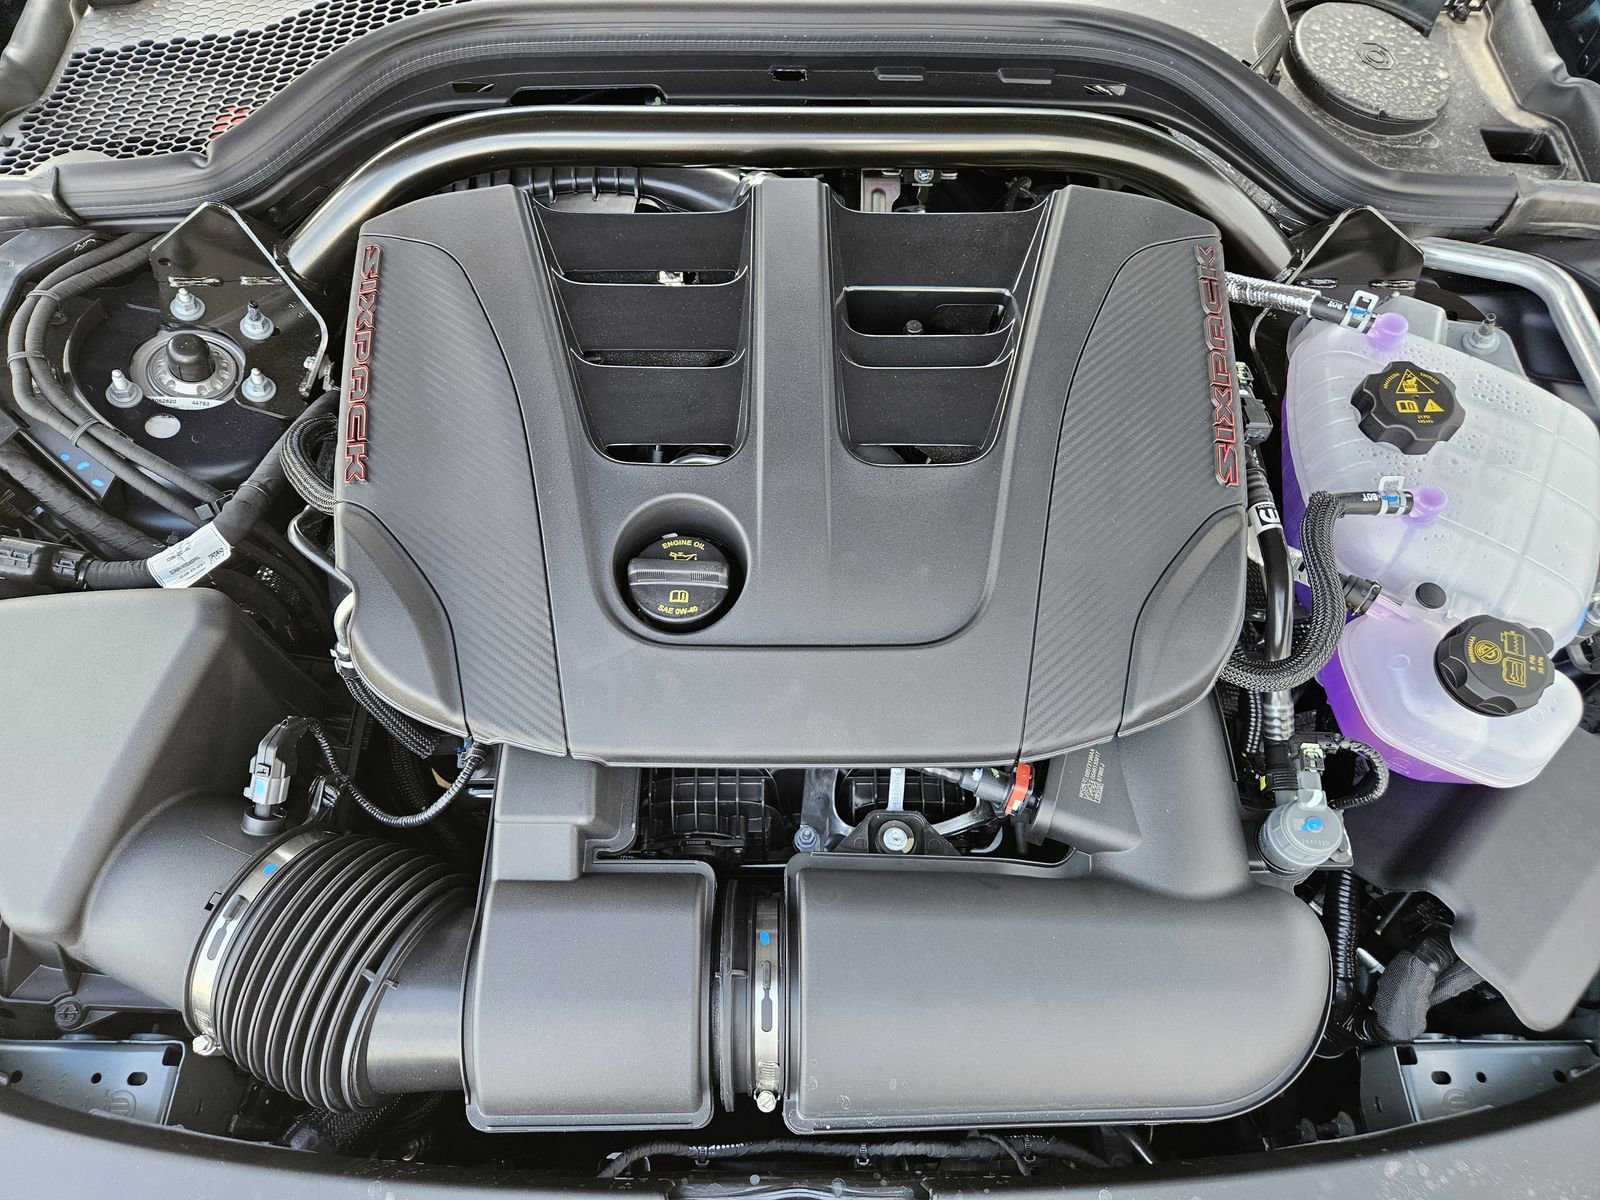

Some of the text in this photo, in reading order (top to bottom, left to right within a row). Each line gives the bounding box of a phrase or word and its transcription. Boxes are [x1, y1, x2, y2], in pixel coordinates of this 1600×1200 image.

[344, 244, 381, 484] SIXPACK
[1195, 244, 1240, 487] SIXPACK
[661, 539, 705, 550] ENGINE OIL
[657, 604, 699, 615] SAE 0W-40
